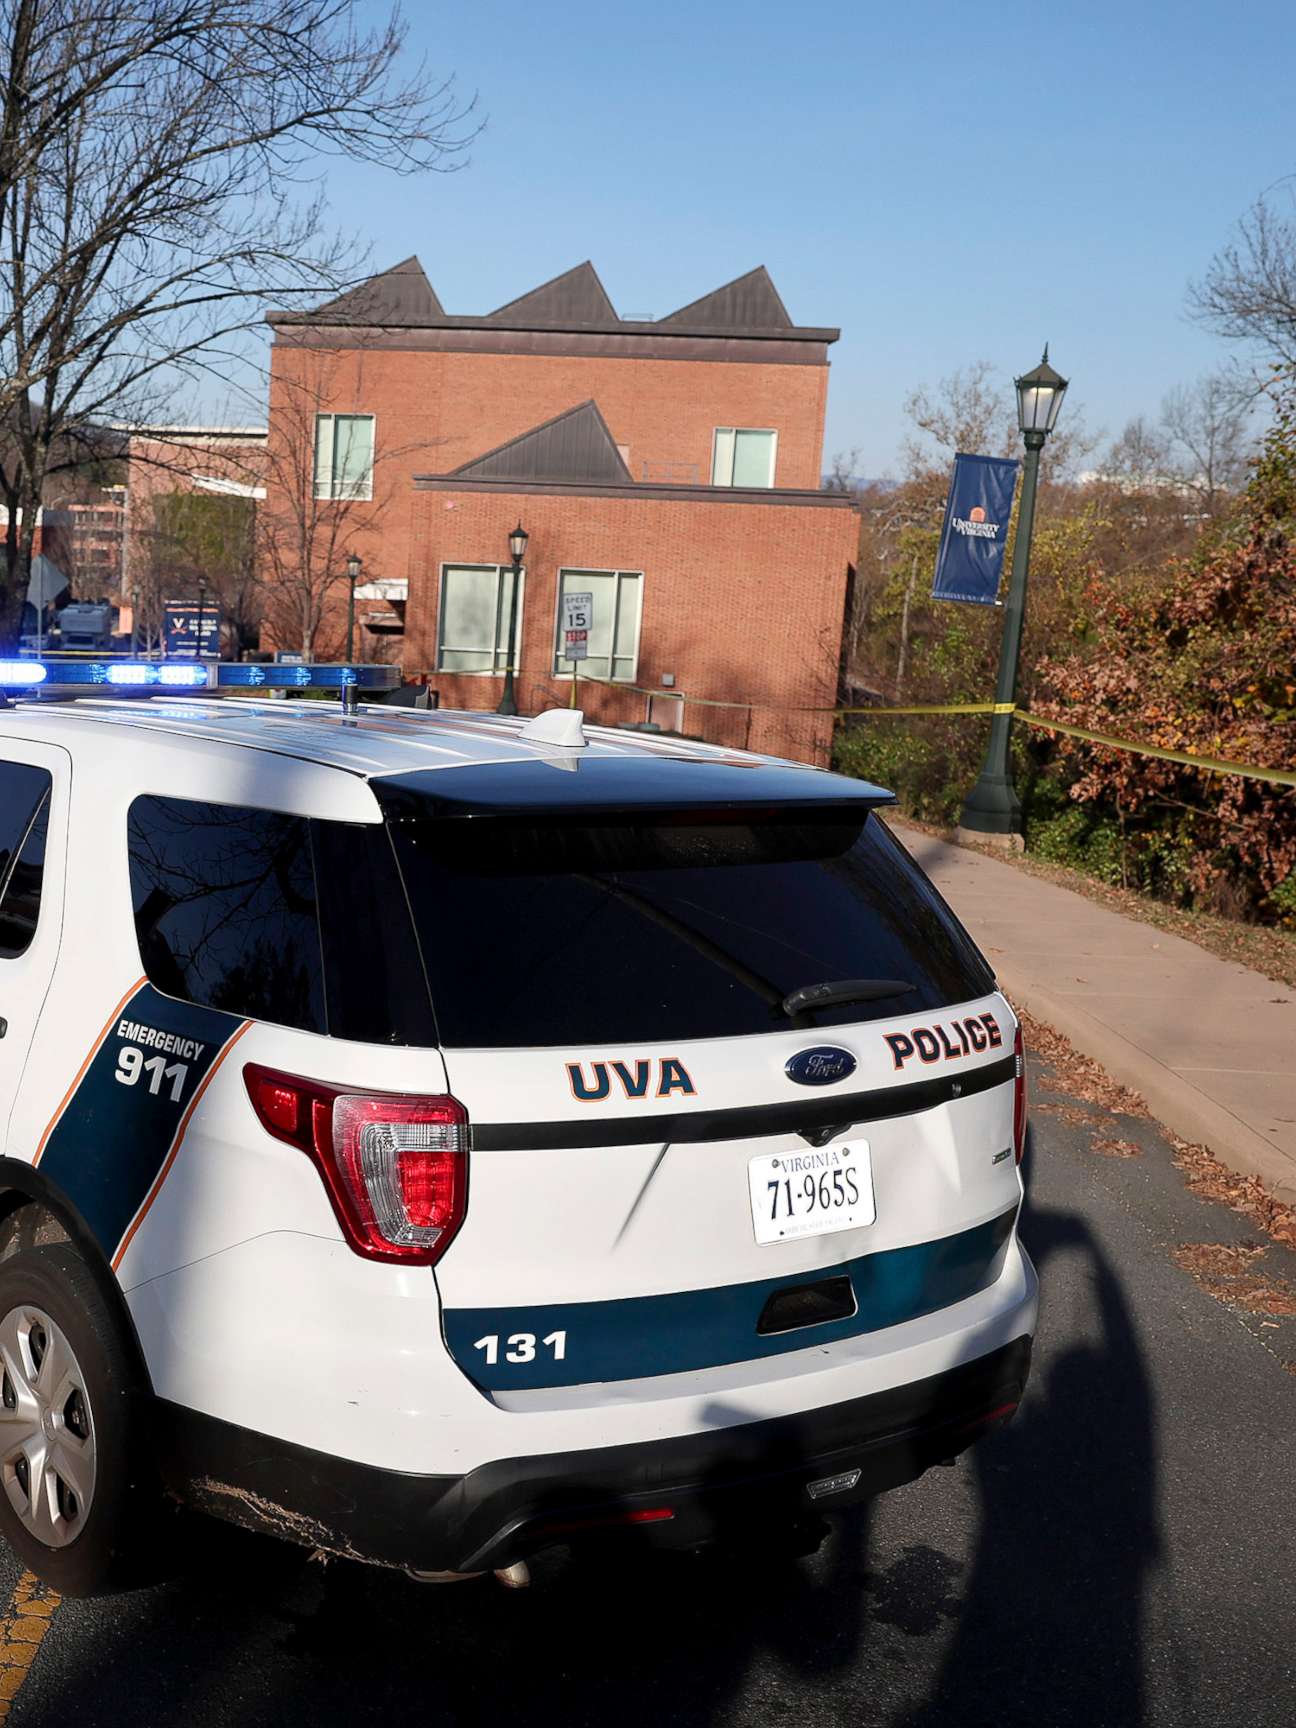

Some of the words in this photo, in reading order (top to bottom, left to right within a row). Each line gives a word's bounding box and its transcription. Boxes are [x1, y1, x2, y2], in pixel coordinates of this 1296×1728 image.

[952, 517, 1000, 532] UNIVERSITY
[568, 612, 586, 627] 15
[117, 1020, 205, 1061] EMERGENCY
[882, 1012, 1003, 1071] POLICE
[115, 1046, 189, 1103] 911
[565, 1057, 698, 1102] UVA
[781, 1151, 840, 1173] VIRGINIA
[767, 1167, 859, 1220] 71-965S
[473, 1331, 567, 1365] 131
